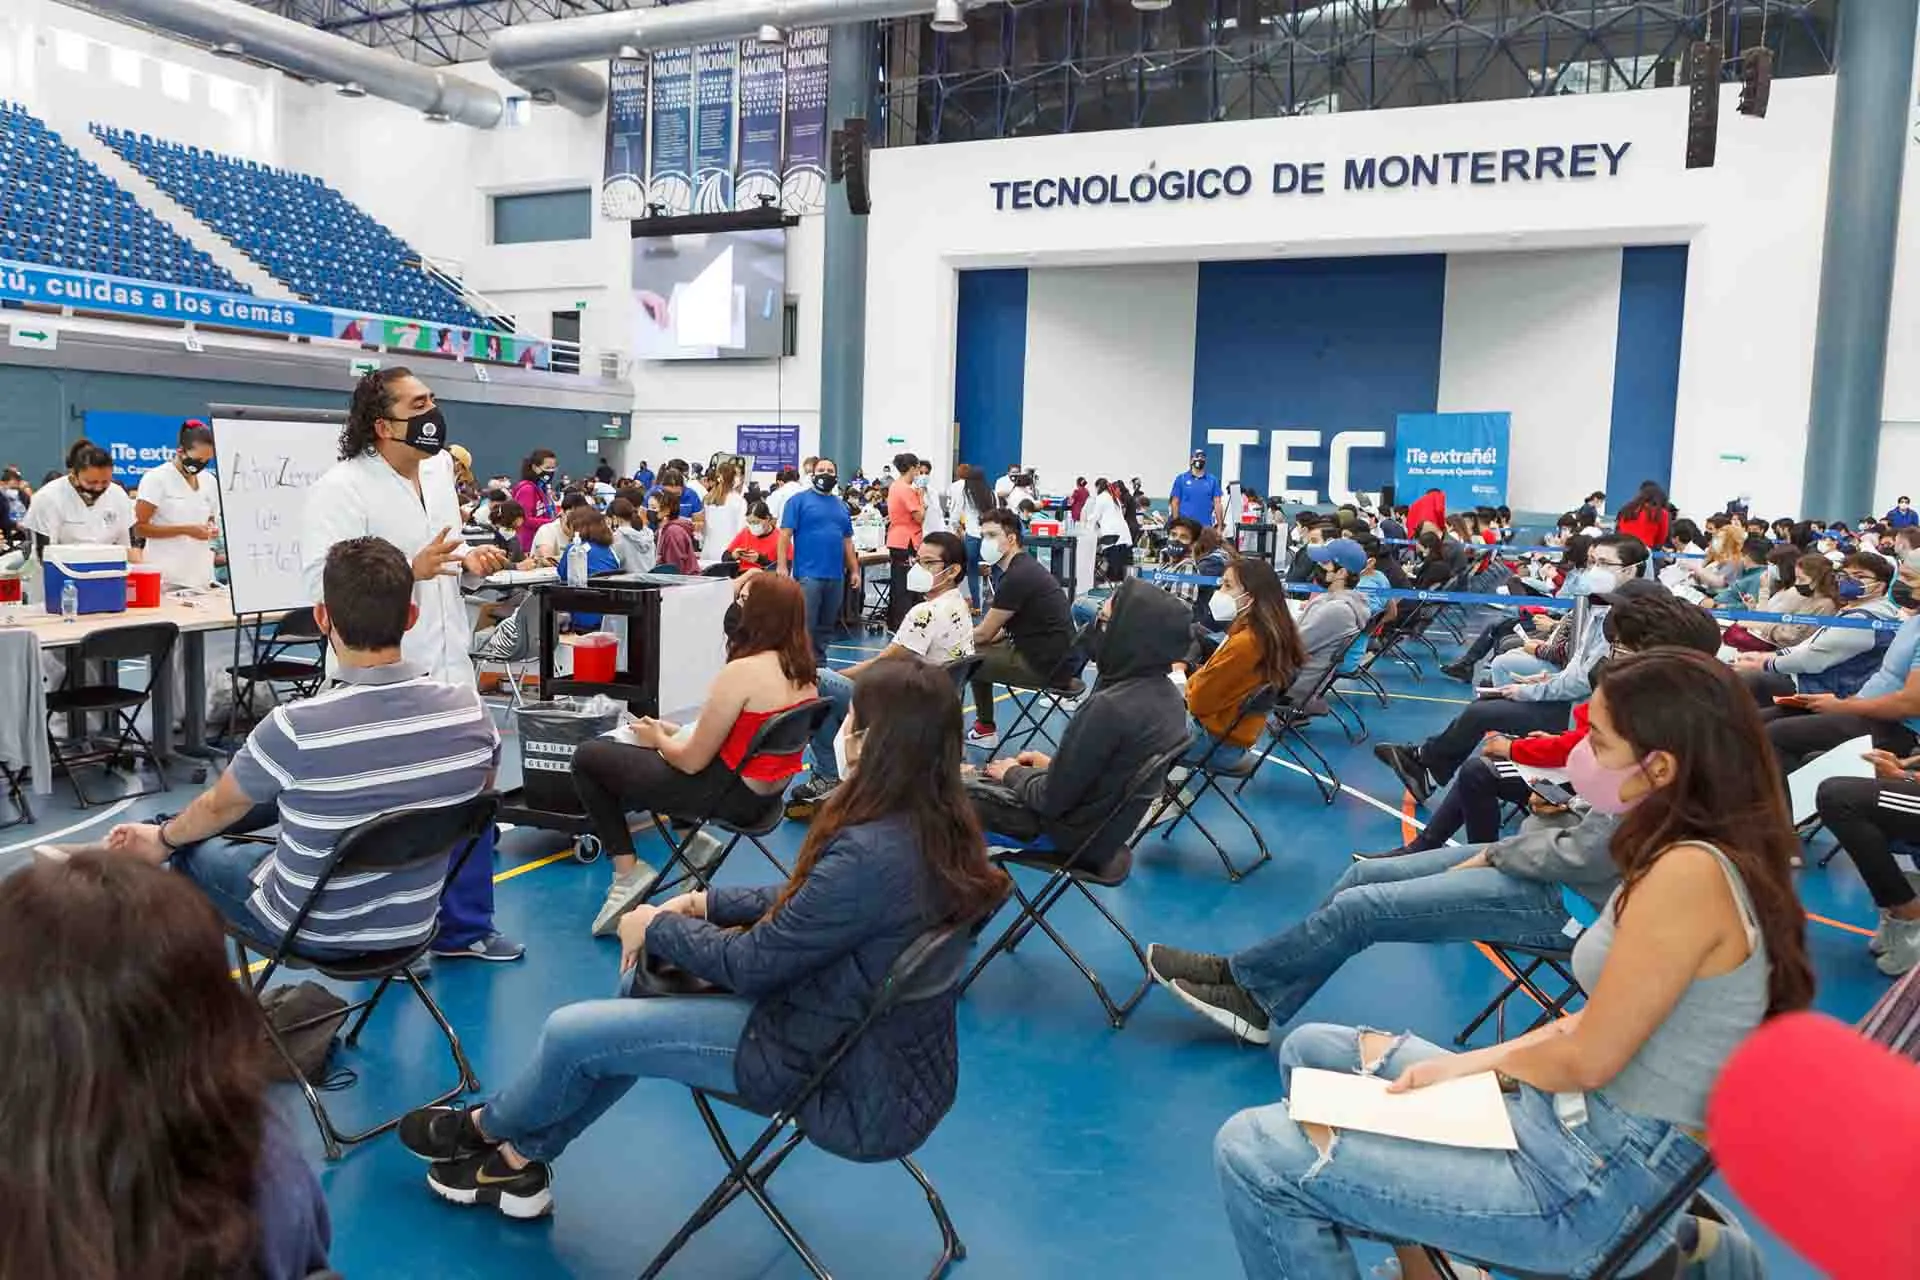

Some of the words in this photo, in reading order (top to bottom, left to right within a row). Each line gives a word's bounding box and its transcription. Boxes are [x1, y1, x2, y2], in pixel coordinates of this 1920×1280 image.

[653, 58, 691, 77] NACIONAL
[741, 55, 784, 76] NACIONAL
[788, 48, 829, 68] NACIONAL
[989, 159, 1252, 210] TECNOLÓGICO
[1272, 161, 1326, 195] DE
[1343, 141, 1633, 191] MONTERREY
[46, 277, 144, 306] cuidas
[151, 293, 167, 311] a
[174, 290, 213, 315] los
[219, 299, 296, 326] demás
[111, 442, 137, 461] ¡Te
[139, 445, 177, 461] extr
[1406, 447, 1429, 465] ¡Te
[1429, 447, 1497, 465] extrañé!
[1207, 429, 1386, 507] TEC
